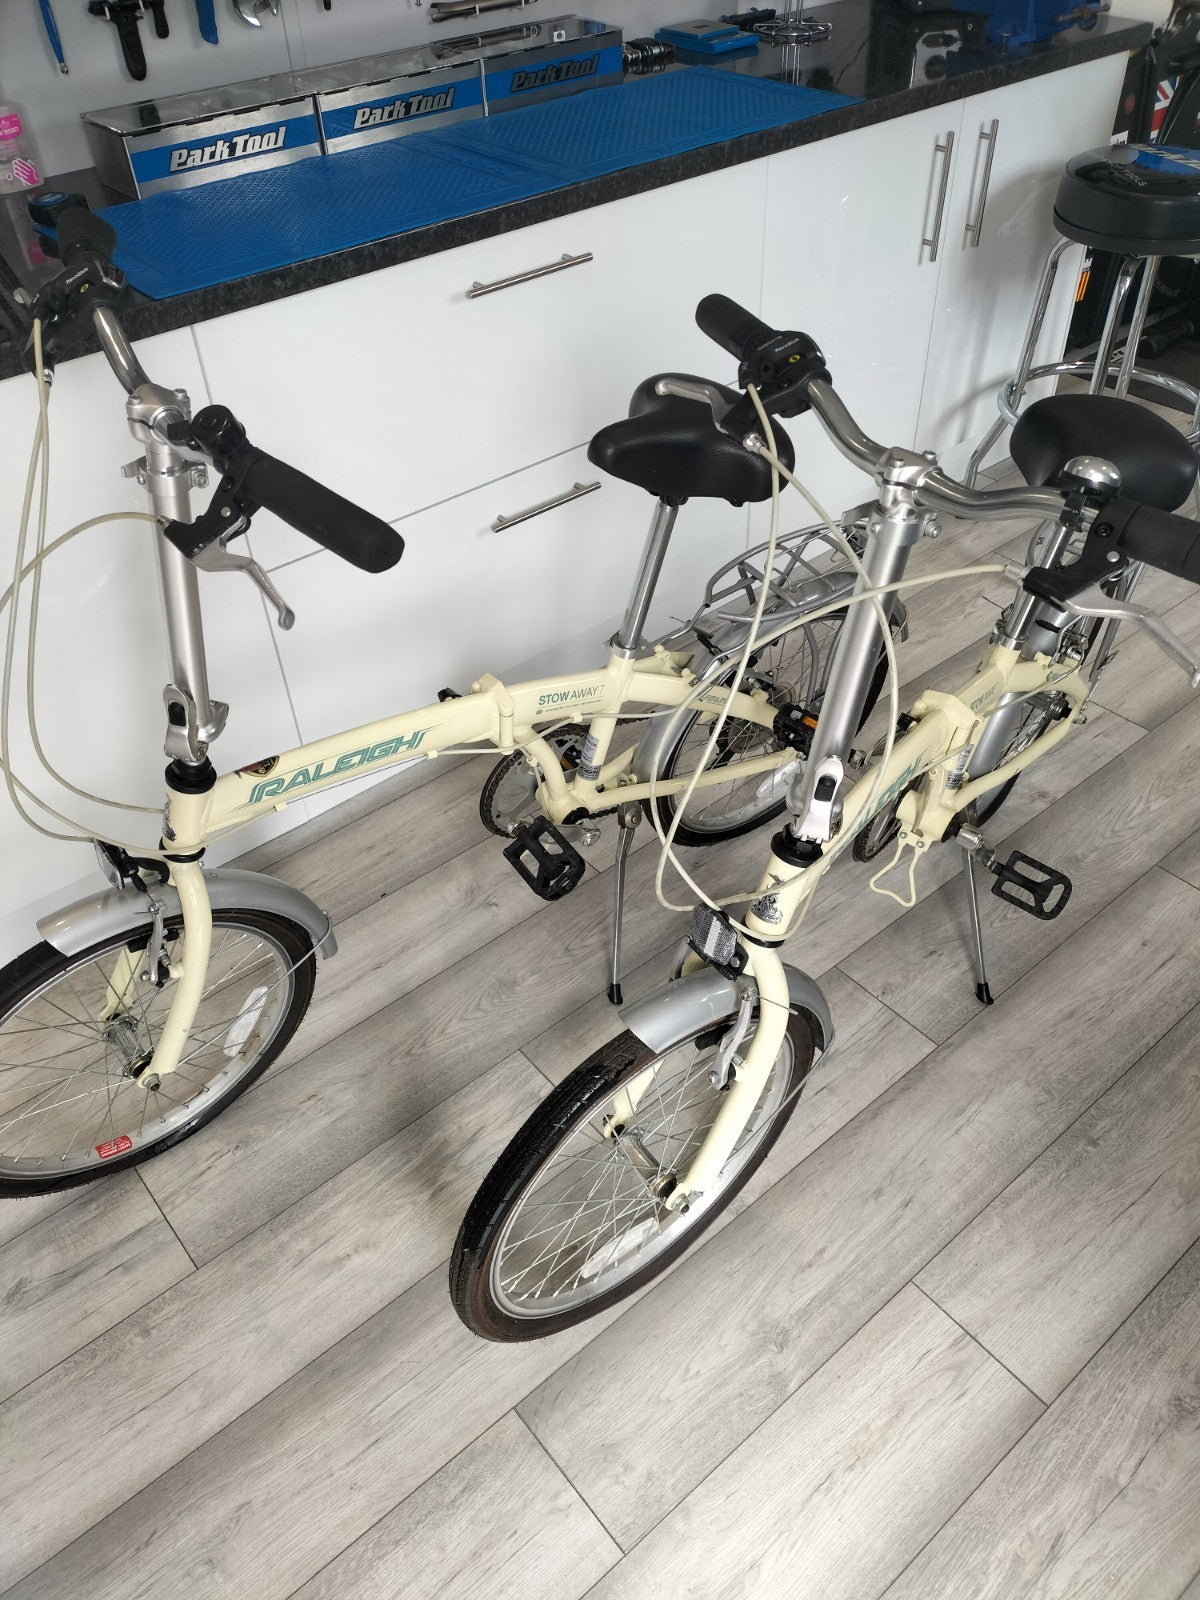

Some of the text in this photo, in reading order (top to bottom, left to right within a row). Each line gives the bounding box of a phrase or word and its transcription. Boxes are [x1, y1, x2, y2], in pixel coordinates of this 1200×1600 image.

[354, 88, 456, 130] Park Tool
[169, 126, 286, 173] Park Tool
[538, 691, 570, 706] STOW
[570, 686, 599, 700] AWAY
[248, 729, 428, 805] RALEIGH
